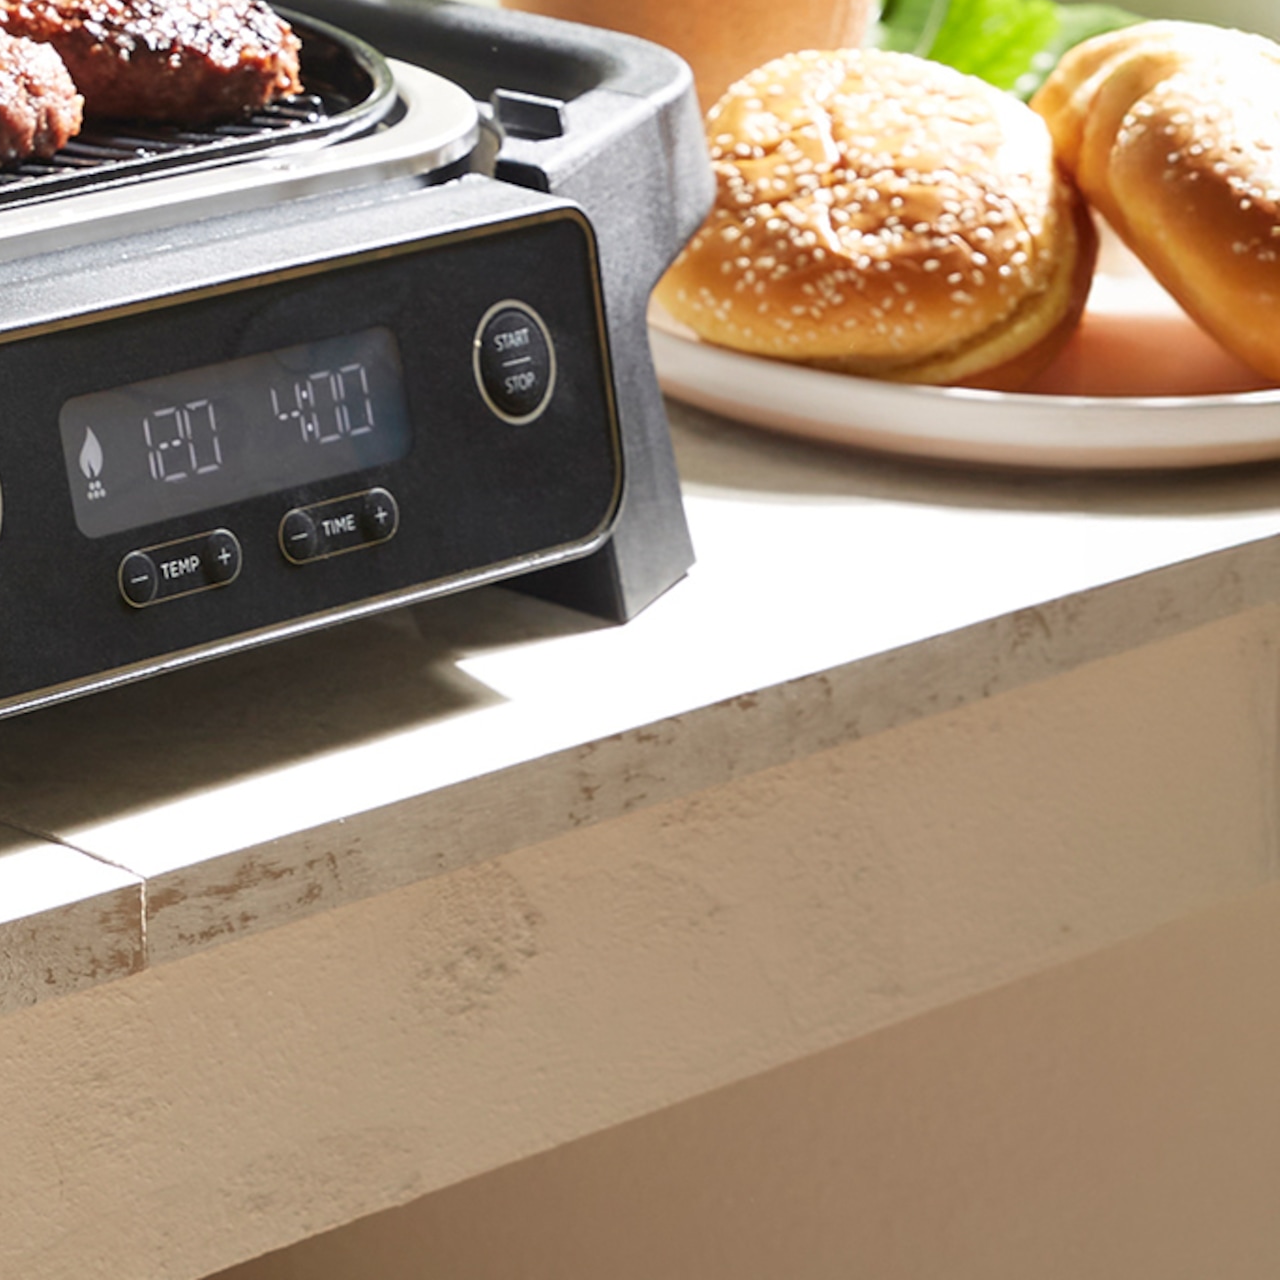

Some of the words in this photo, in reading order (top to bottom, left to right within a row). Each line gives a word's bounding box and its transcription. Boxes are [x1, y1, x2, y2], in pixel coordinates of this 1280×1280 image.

[495, 328, 529, 352] START
[504, 372, 536, 394] STOP
[143, 399, 223, 482] 120
[270, 363, 375, 444] 4:00
[321, 514, 356, 536] TIME
[160, 554, 201, 580] TEMP
